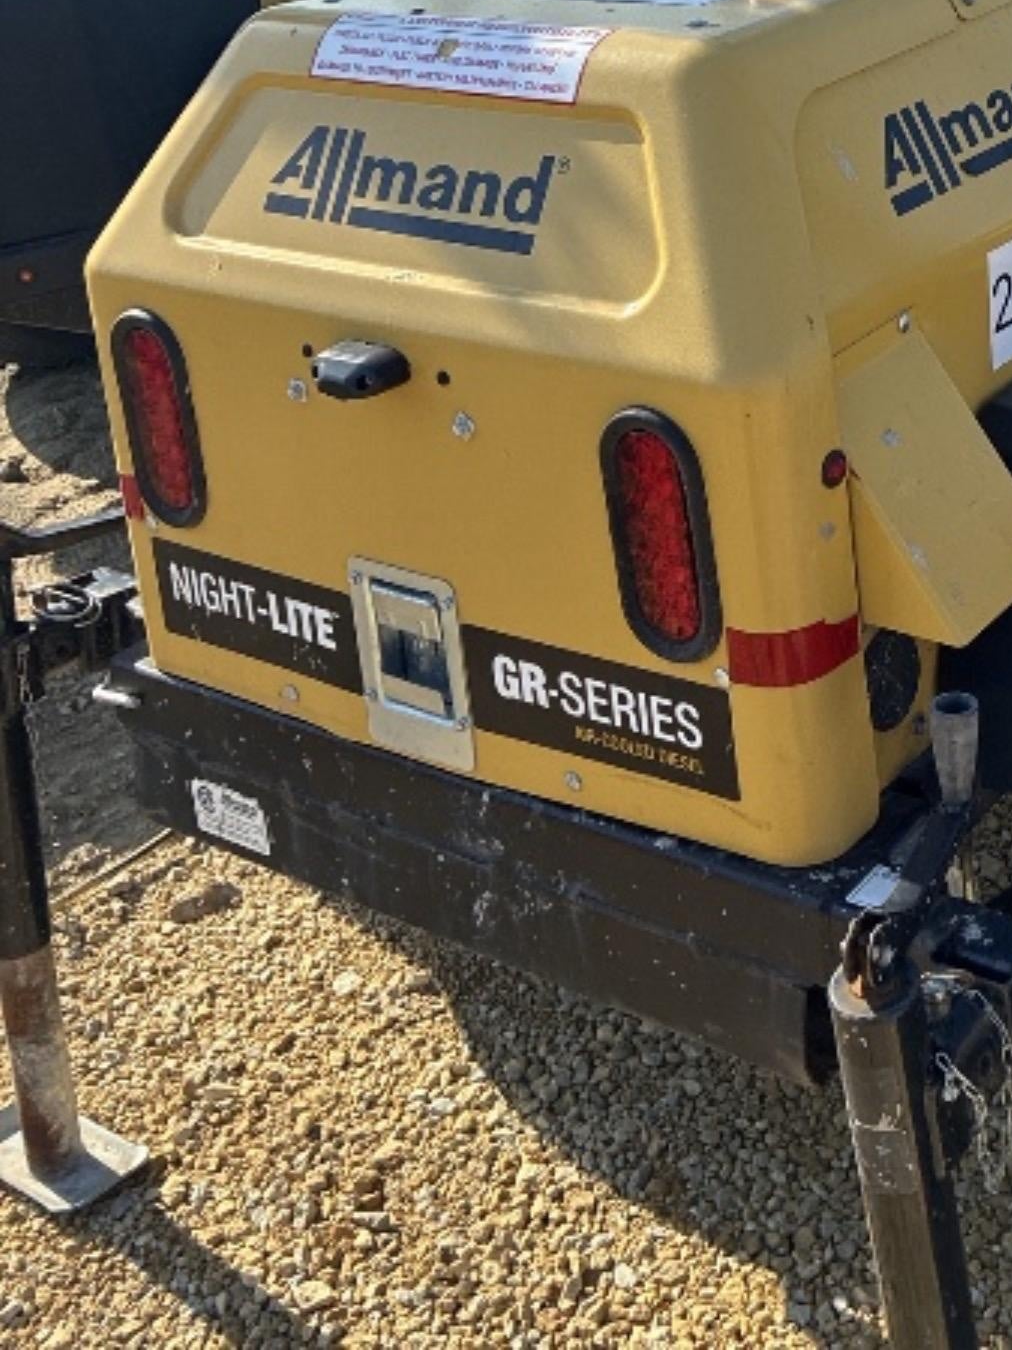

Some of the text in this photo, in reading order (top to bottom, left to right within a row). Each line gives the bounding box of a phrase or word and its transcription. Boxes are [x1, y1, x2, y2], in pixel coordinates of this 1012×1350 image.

[269, 125, 556, 225] Allmand
[169, 561, 338, 651] NIGHT-LITE
[491, 653, 704, 749] GR-SERIES
